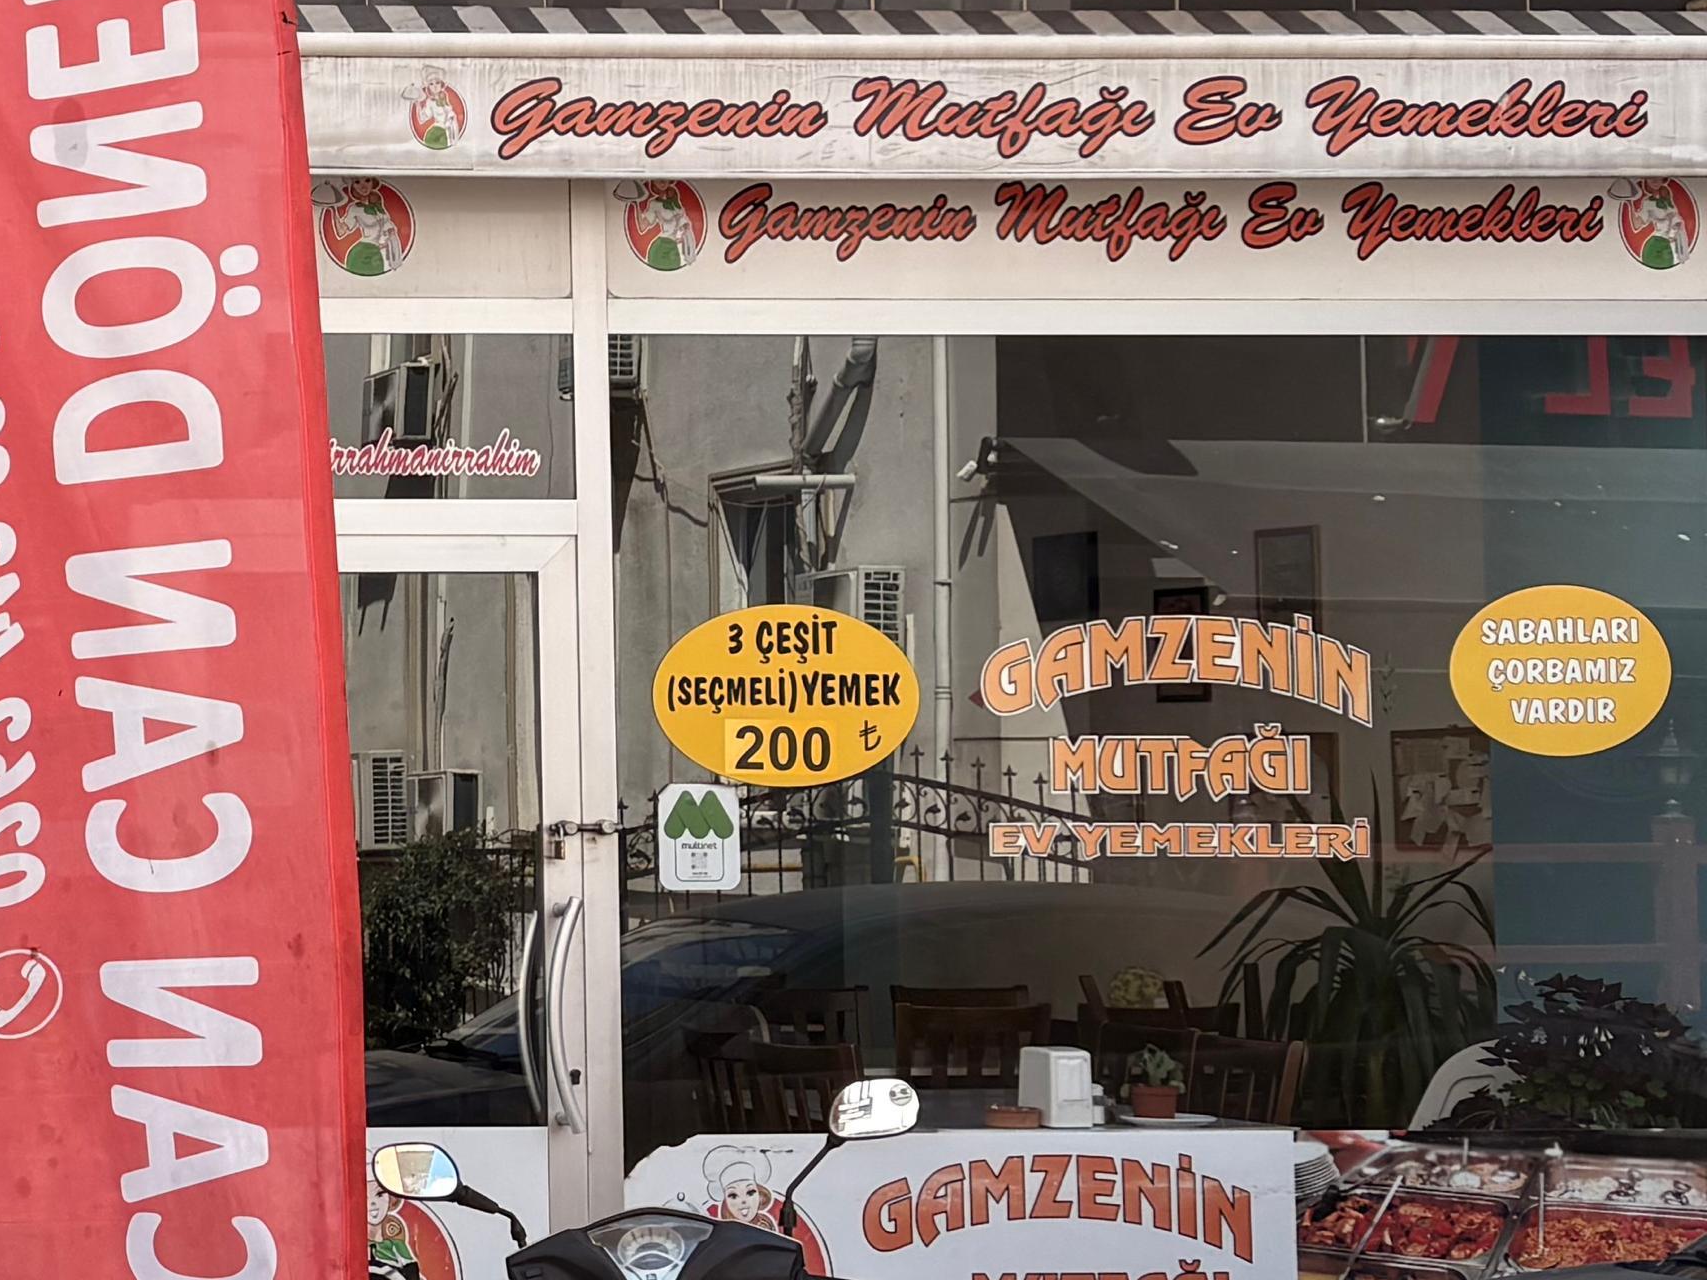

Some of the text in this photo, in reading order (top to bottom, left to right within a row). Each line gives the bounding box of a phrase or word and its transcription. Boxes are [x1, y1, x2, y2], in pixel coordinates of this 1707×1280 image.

[491, 75, 1649, 160] Gamzenin Mutfağı Ev Yemekleri
[718, 180, 1605, 264] Gamzenin Mutfağı Ev Yemekleri
[728, 614, 838, 664] 3 ÇEŞİT
[1480, 617, 1639, 646] SABAHLARI
[980, 613, 1373, 728] GAMZENİN
[1487, 657, 1637, 691] ÇORBAMIZ
[1509, 697, 1617, 726] VARDIR
[734, 725, 832, 772] 200
[1048, 723, 1312, 802] MUTFAĞI
[681, 841, 718, 849] multinet
[989, 817, 1370, 860] EV YEMEKLERİ
[862, 1152, 1253, 1264] GAMZENİN
